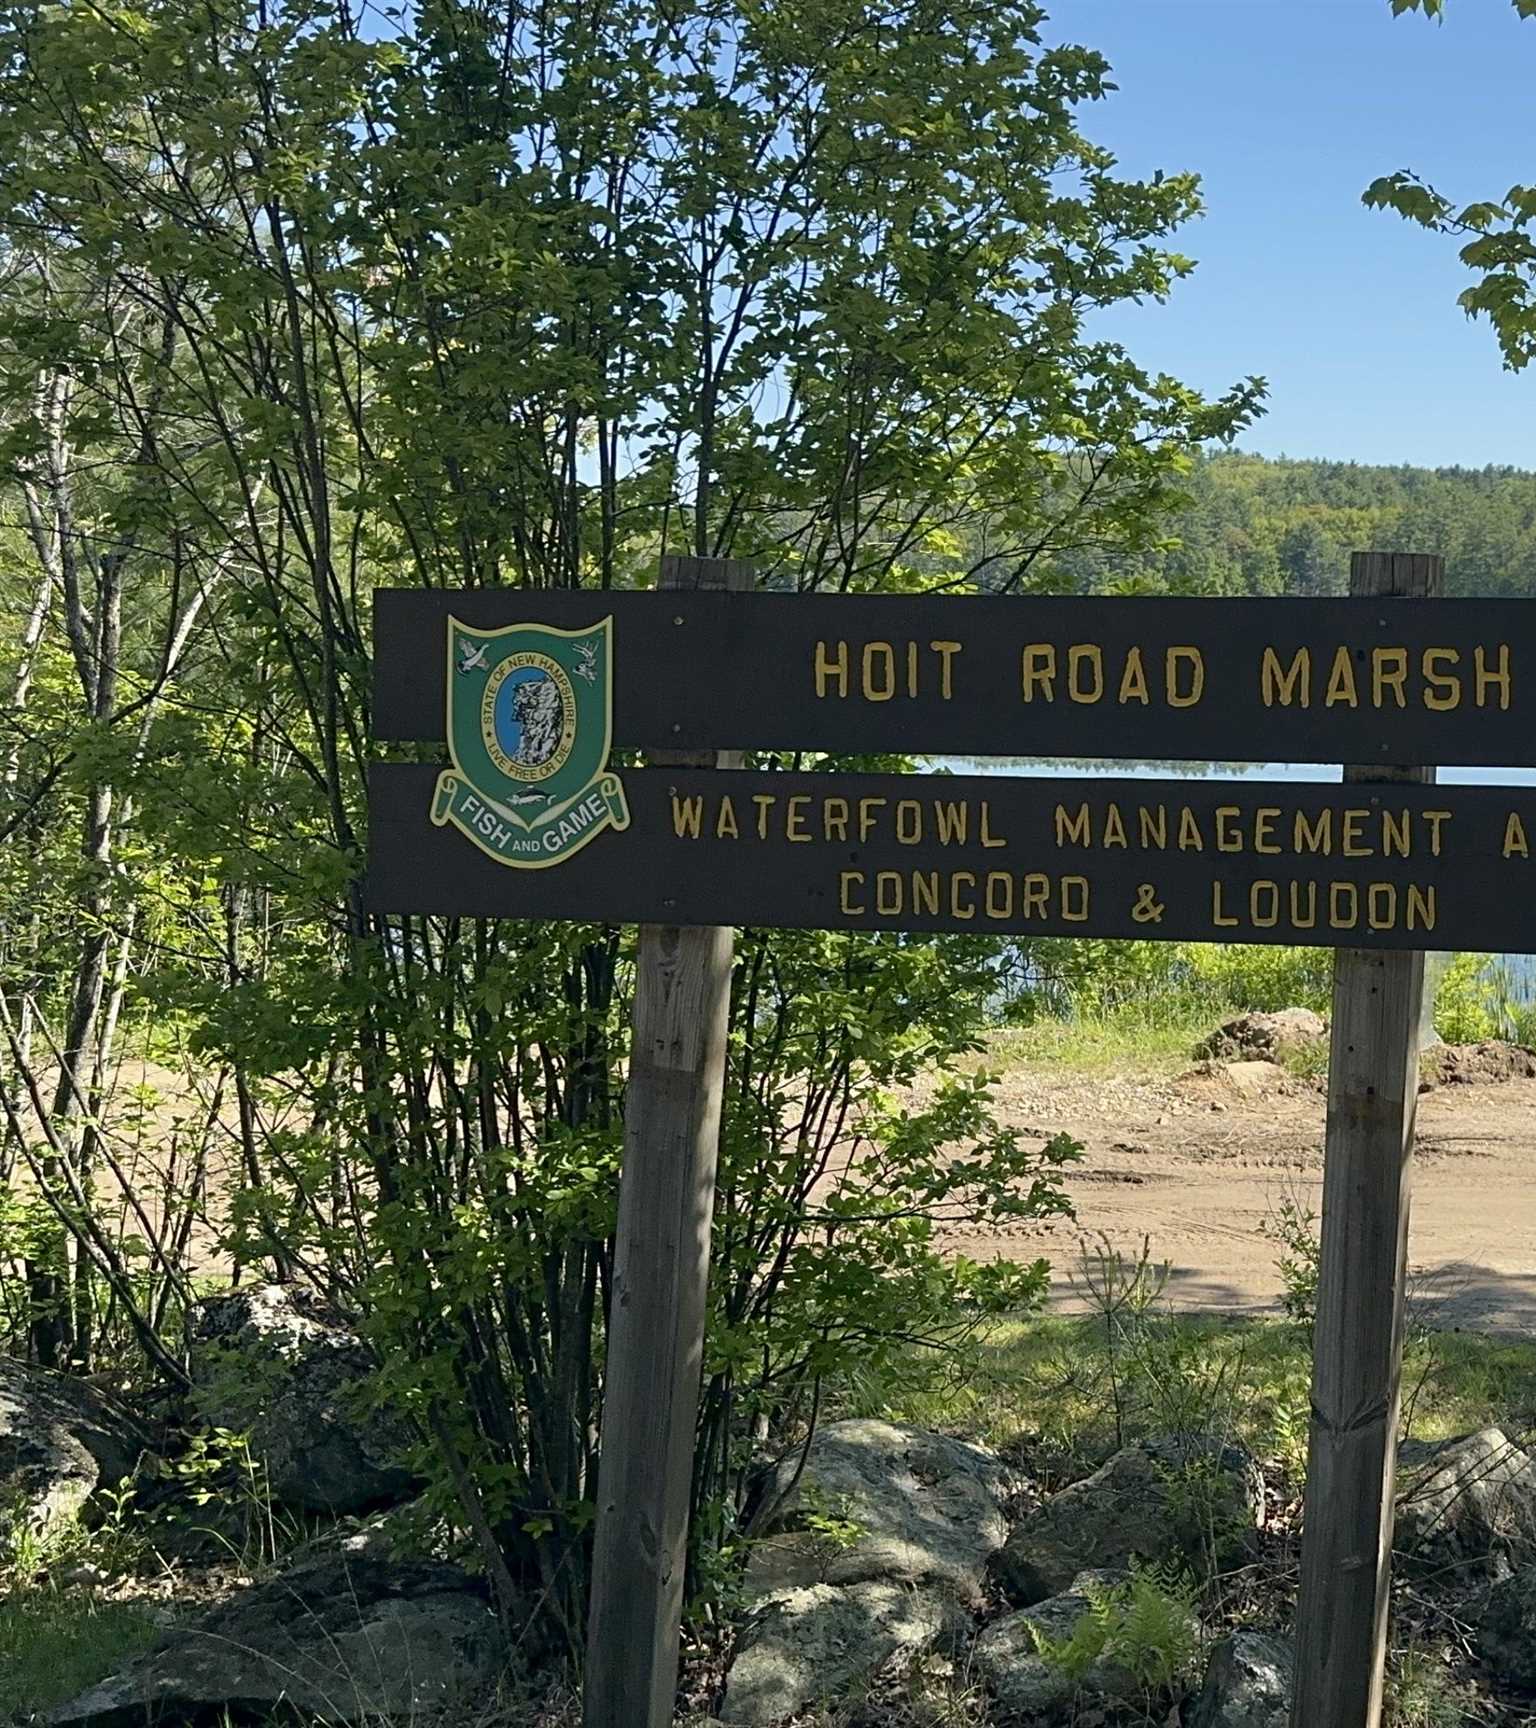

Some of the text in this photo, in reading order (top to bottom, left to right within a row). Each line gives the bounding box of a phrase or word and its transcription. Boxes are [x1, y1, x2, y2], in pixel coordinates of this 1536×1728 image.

[483, 654, 576, 726] STATE OF NEW HAMPSHIRE
[815, 640, 1512, 712] HOIT ROAD MARSH
[488, 743, 570, 780] LIVE FREE OR DIE
[460, 793, 607, 852] FISH AND GAME
[672, 795, 1007, 848] WATERFOWL
[1055, 802, 1453, 858] MANAGEMENT
[840, 870, 1437, 932] CONCORD & LOUDON
